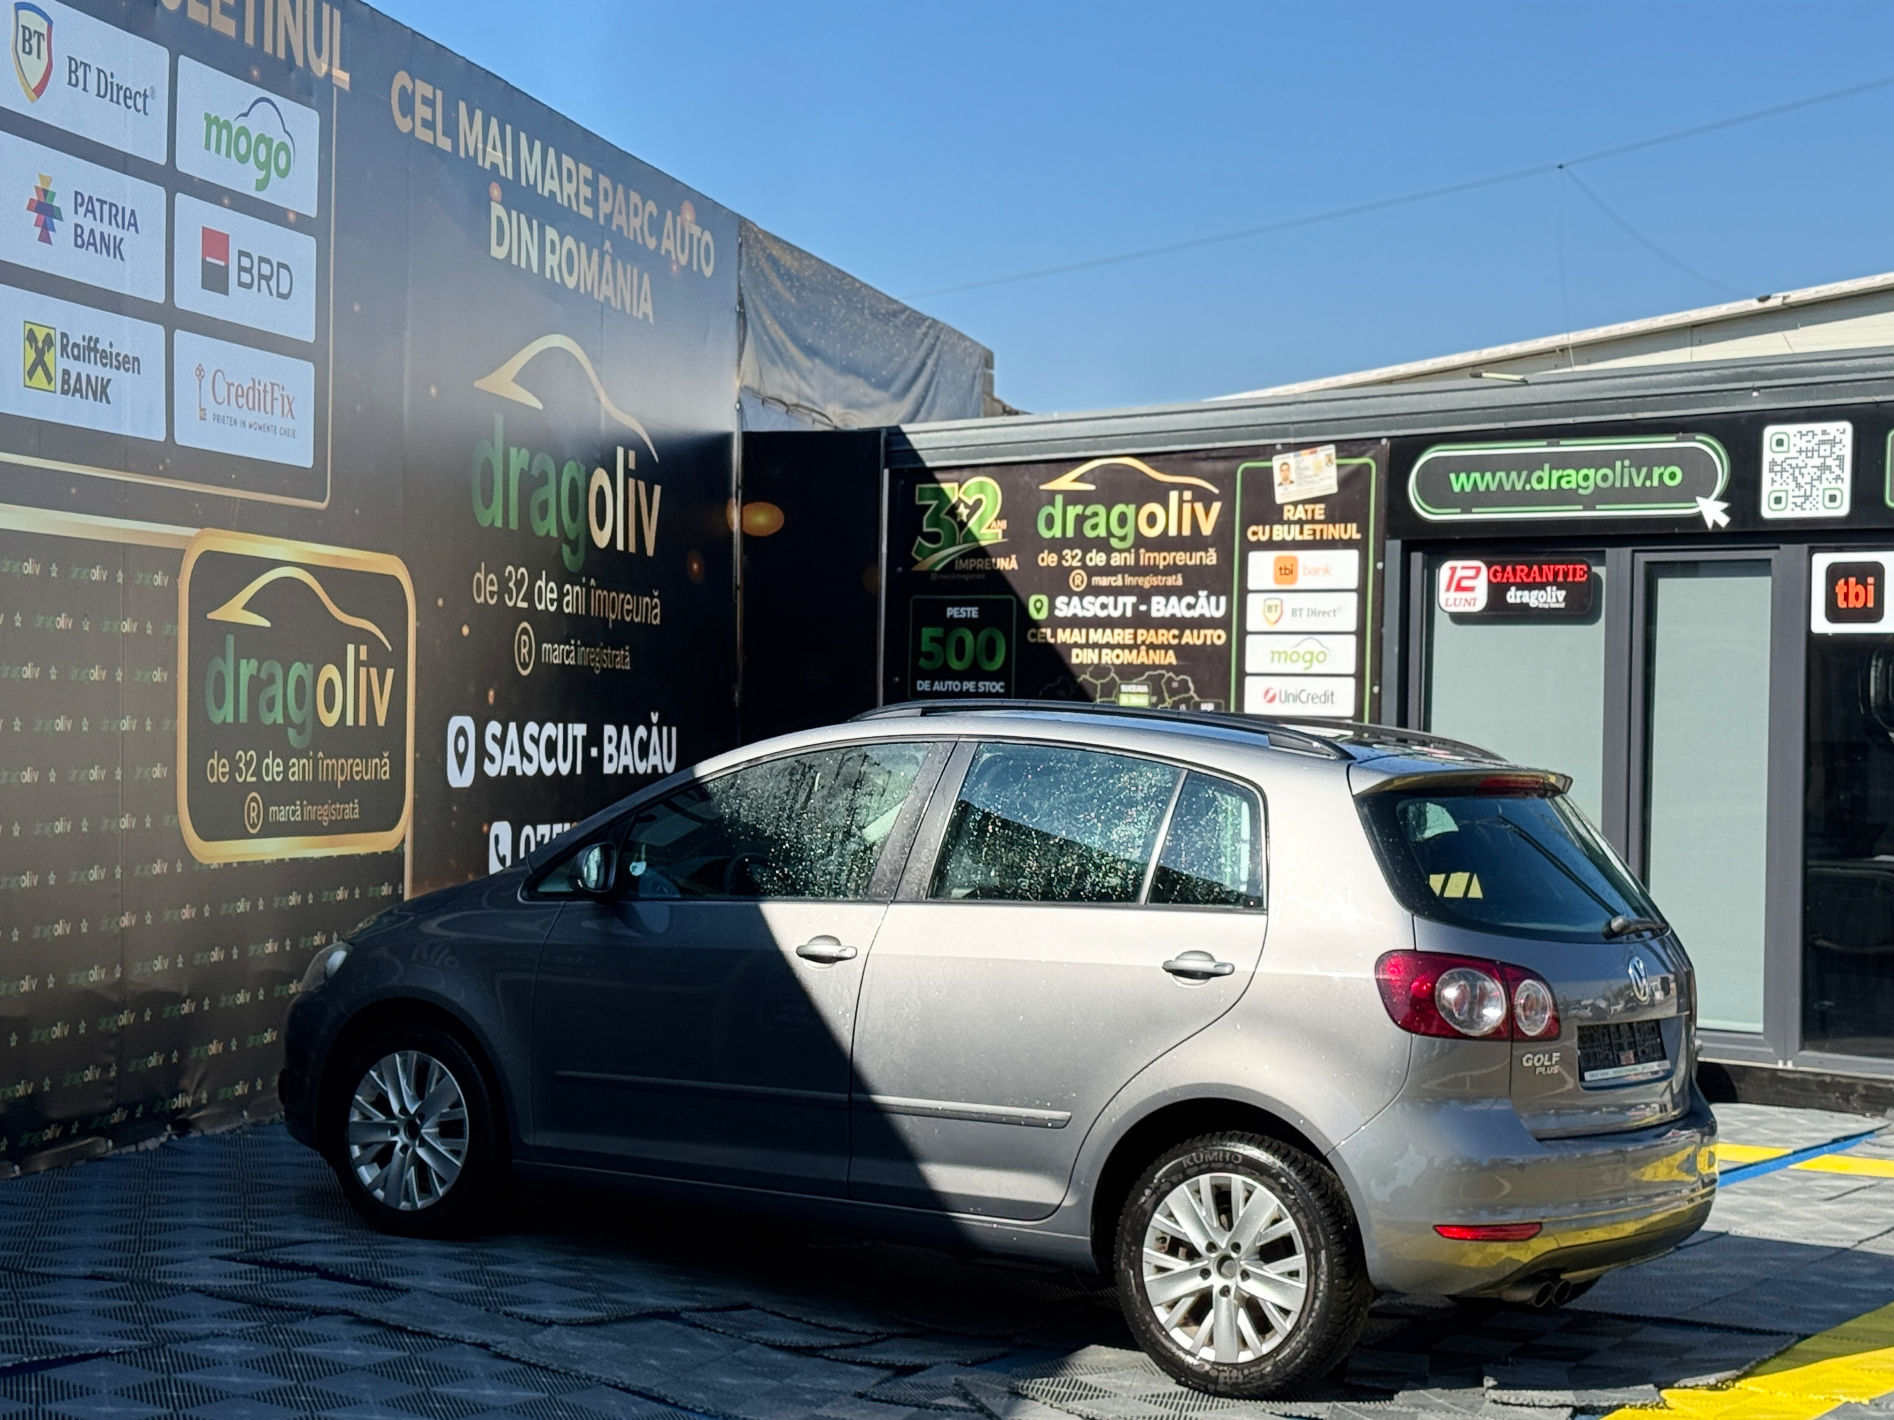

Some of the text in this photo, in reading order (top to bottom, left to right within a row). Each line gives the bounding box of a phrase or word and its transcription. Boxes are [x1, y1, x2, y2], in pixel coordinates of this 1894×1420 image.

[20, 25, 45, 60] BT
[67, 55, 91, 90] BT
[203, 112, 292, 191] mogo
[390, 70, 715, 278] CEL MAI MARE PARC AUTO
[73, 190, 140, 235] PATRIA
[73, 223, 125, 262] BANK
[237, 249, 294, 300] BRD
[490, 201, 655, 325] DIN ROMÂNIA
[60, 331, 141, 376] Raiffeisen
[60, 369, 112, 405] BANK
[211, 368, 296, 420] CreditFix
[1449, 459, 1683, 496] www.dragoliv.ro
[471, 411, 662, 573] dragoliv
[911, 476, 1002, 561] 32
[989, 519, 1008, 530] ANI
[1036, 490, 1222, 549] dragoliv
[1283, 504, 1325, 521] RATE
[1247, 523, 1361, 542] CU BULETINUL
[1037, 547, 1217, 569] de 32 de ani împreună
[1278, 564, 1332, 577] tbi bank
[1091, 574, 1123, 586] marcă
[1444, 565, 1482, 593] 12
[1488, 564, 1589, 584] GARANTIE
[472, 561, 661, 629] de 32 de ani împreună
[1053, 595, 1137, 618] SASCUT
[1150, 590, 1227, 618] BACĂU
[1444, 597, 1477, 608] LUNI
[1506, 586, 1567, 608] dragoliv
[1835, 576, 1876, 609] tbi
[946, 607, 979, 618] PESTE
[1267, 604, 1279, 614] BT
[1291, 608, 1304, 618] BT
[918, 626, 1006, 672] 500
[1027, 628, 1227, 646] CEL MAI MARE PARC AUTO
[541, 638, 576, 666] marcă
[1071, 645, 1178, 665] DIN ROMÂNIA
[1270, 649, 1327, 670] mogo
[205, 634, 395, 749] dragoliv
[916, 680, 1006, 693] DE AUTO PE STOC
[1278, 689, 1335, 704] UniCredit
[483, 721, 587, 777] SASCUT
[602, 711, 677, 775] BACĂU
[207, 749, 391, 789] de 32 de ani împreună
[269, 799, 302, 823] marcă
[303, 799, 360, 827] înregistrată
[1521, 1052, 1561, 1068] GOLF
[1535, 1066, 1560, 1076] PLUS
